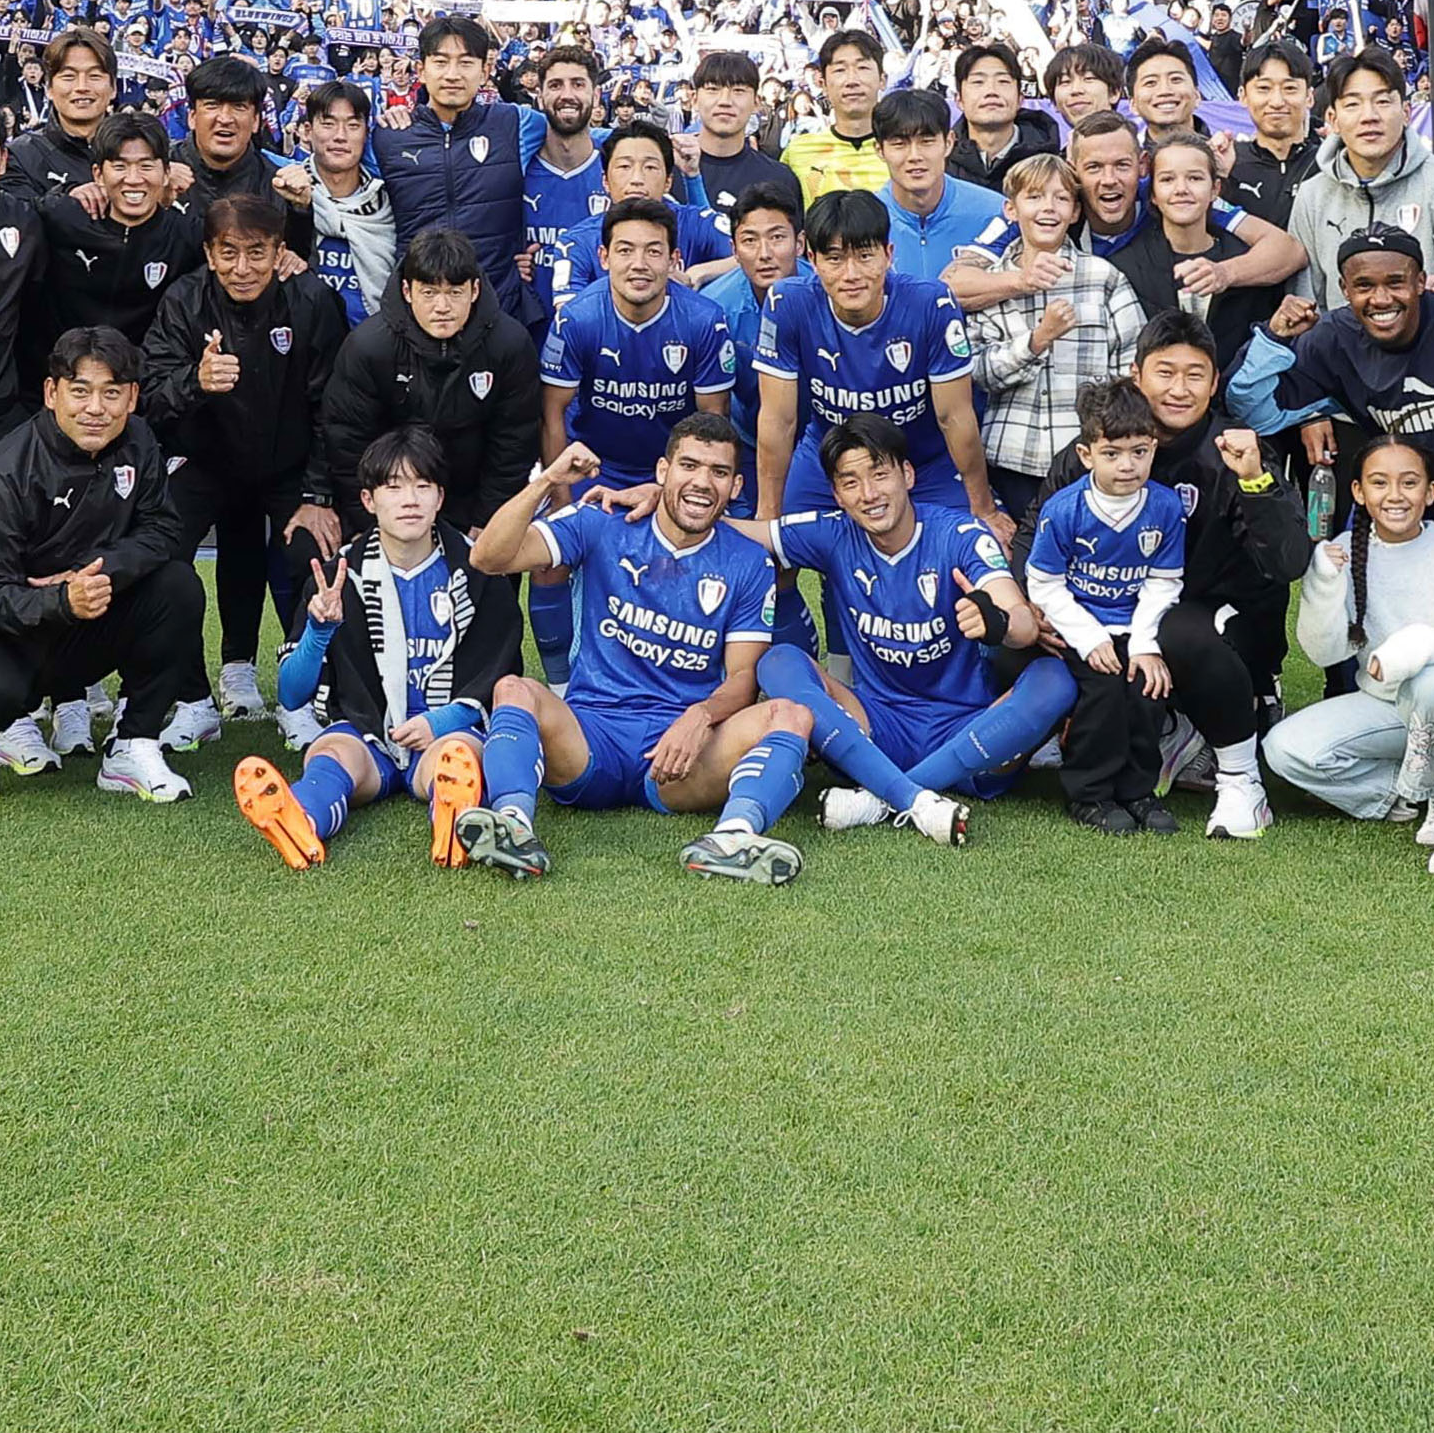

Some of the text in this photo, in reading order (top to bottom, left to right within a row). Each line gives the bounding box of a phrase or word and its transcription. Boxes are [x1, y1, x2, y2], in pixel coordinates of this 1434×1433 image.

[593, 378, 688, 399] SAMSUNG
[810, 377, 927, 412] SAMSUNG
[590, 394, 687, 422] Galaxy S25
[892, 401, 927, 428] S25
[607, 595, 719, 650] SAMSUNG
[598, 618, 710, 672] Galaxy S25
[917, 636, 954, 664] S25
